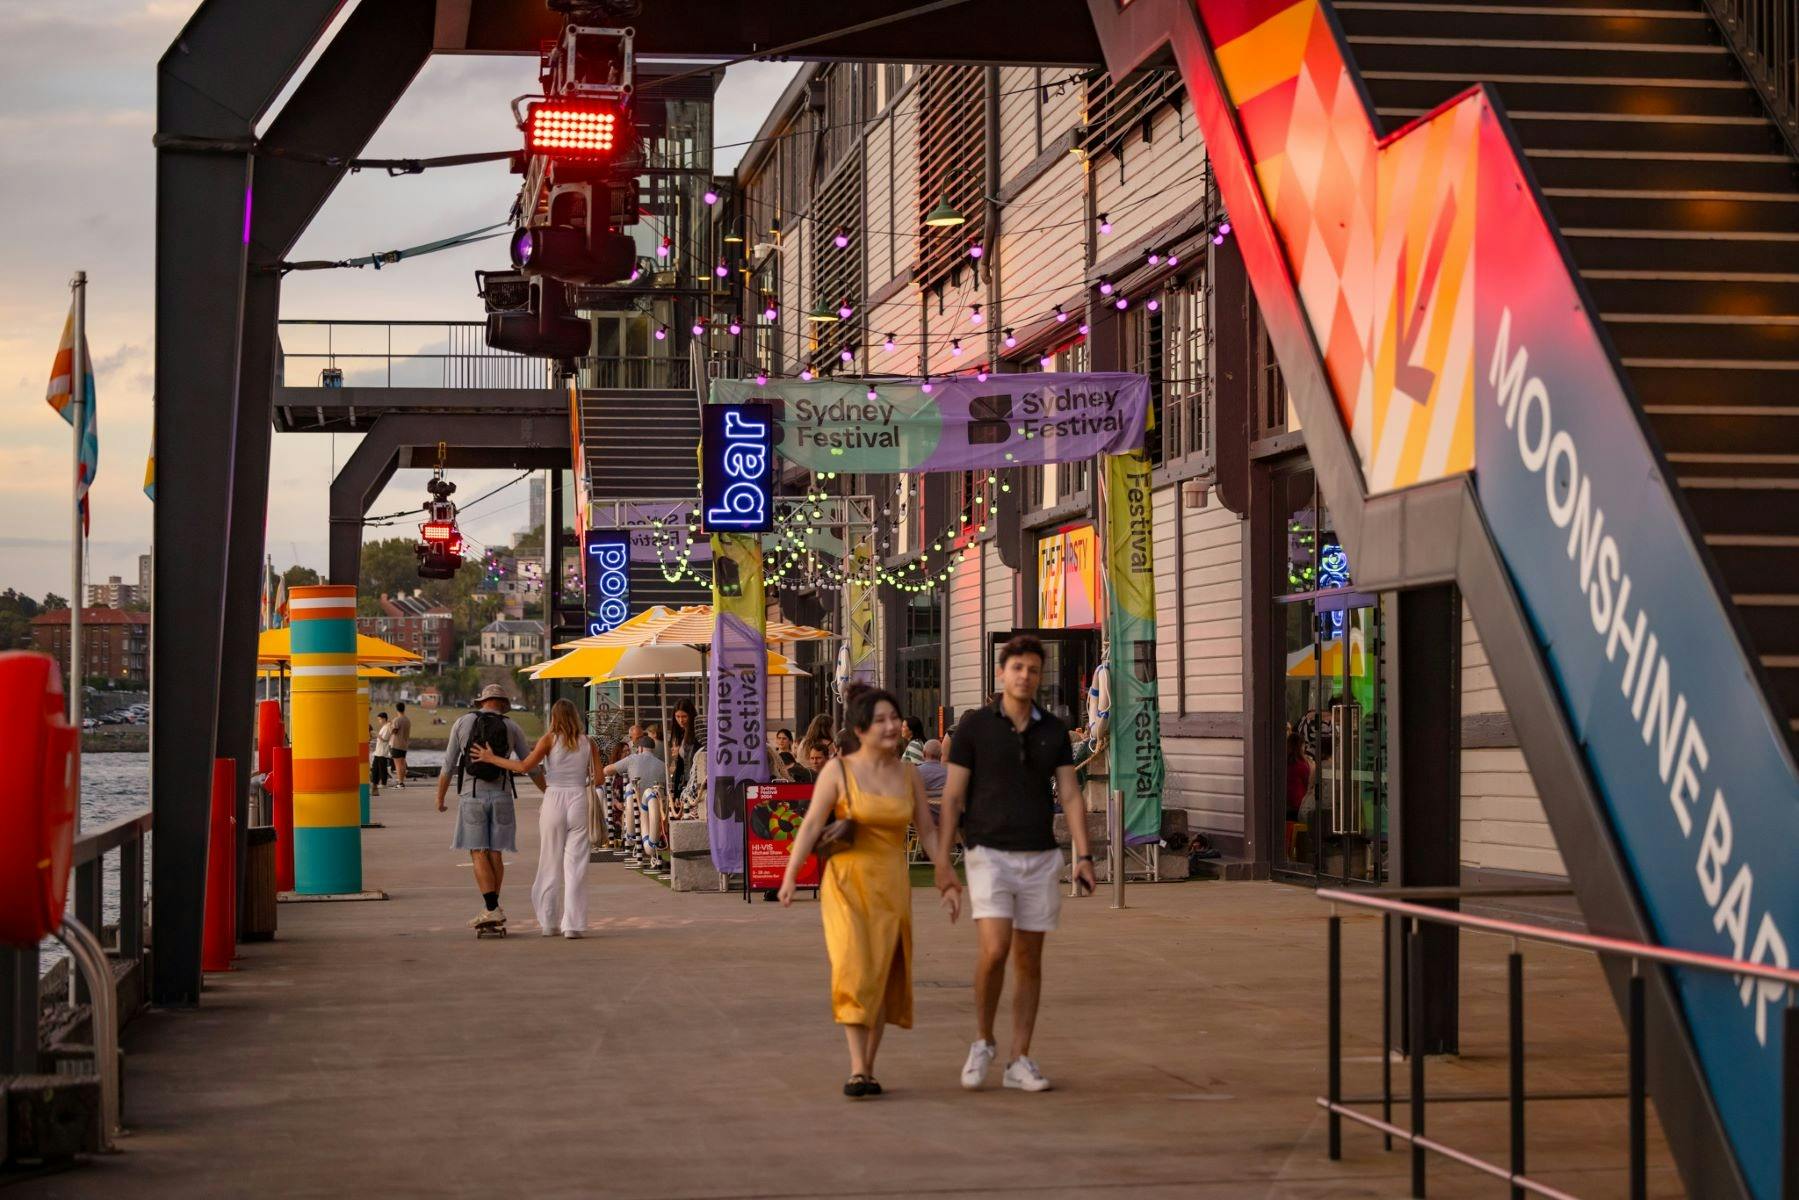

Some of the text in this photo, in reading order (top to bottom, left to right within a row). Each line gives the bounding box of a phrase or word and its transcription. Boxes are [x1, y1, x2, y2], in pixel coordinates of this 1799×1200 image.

[795, 398, 895, 427] Sydney
[1022, 388, 1120, 419] Sydney
[796, 425, 900, 449] Festival
[1023, 409, 1123, 440] Festival
[708, 411, 766, 524] bar
[1127, 472, 1153, 574] Festival
[1041, 538, 1088, 579] THE THIRSTY
[1042, 588, 1058, 621] MILE
[1488, 308, 1789, 1047] MOONSHINE BAR
[716, 665, 738, 766] Sydney
[733, 663, 760, 766] Festival
[1135, 695, 1158, 799] Festival
[751, 843, 774, 851] HI-VIS
